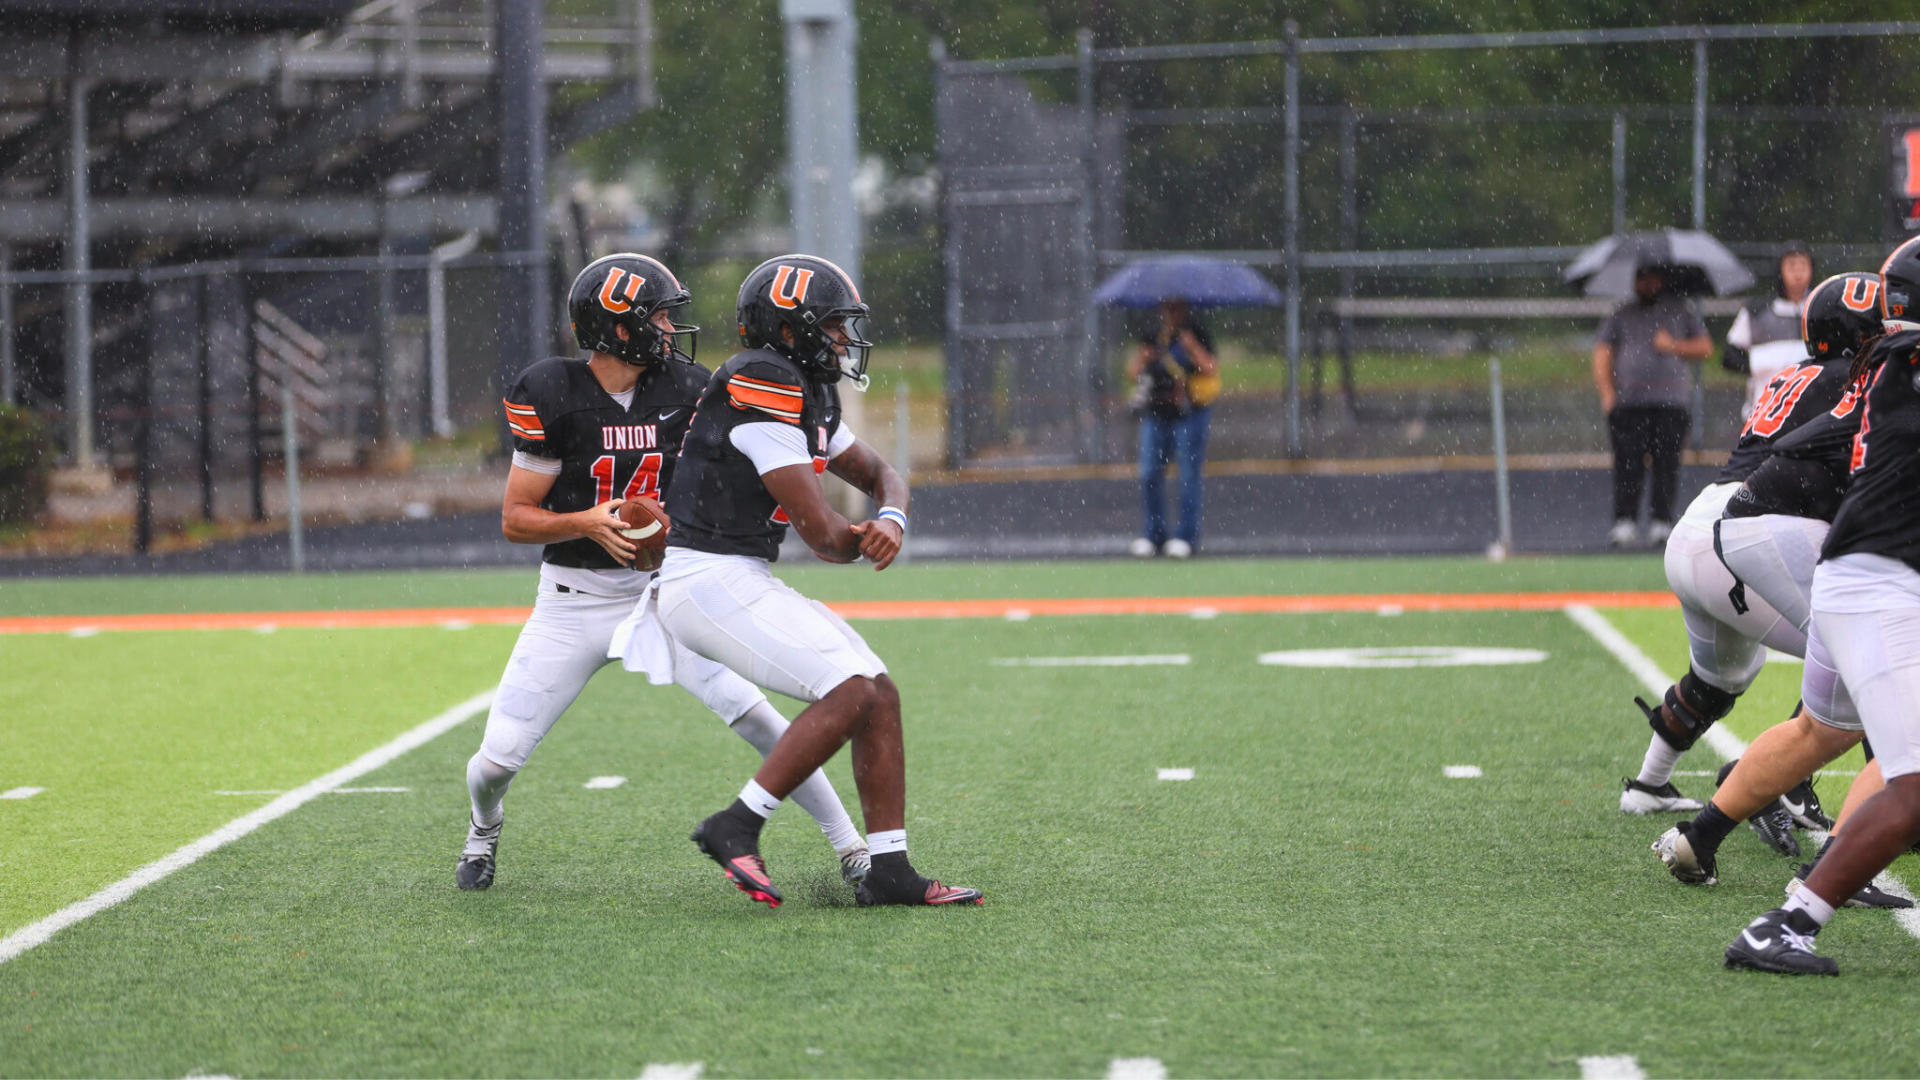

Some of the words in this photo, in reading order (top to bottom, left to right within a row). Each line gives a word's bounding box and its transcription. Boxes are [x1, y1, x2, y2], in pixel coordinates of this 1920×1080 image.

[598, 266, 646, 314] U
[769, 265, 814, 310] U
[1842, 277, 1880, 312] U
[602, 424, 656, 450] UNION
[590, 453, 663, 507] 14
